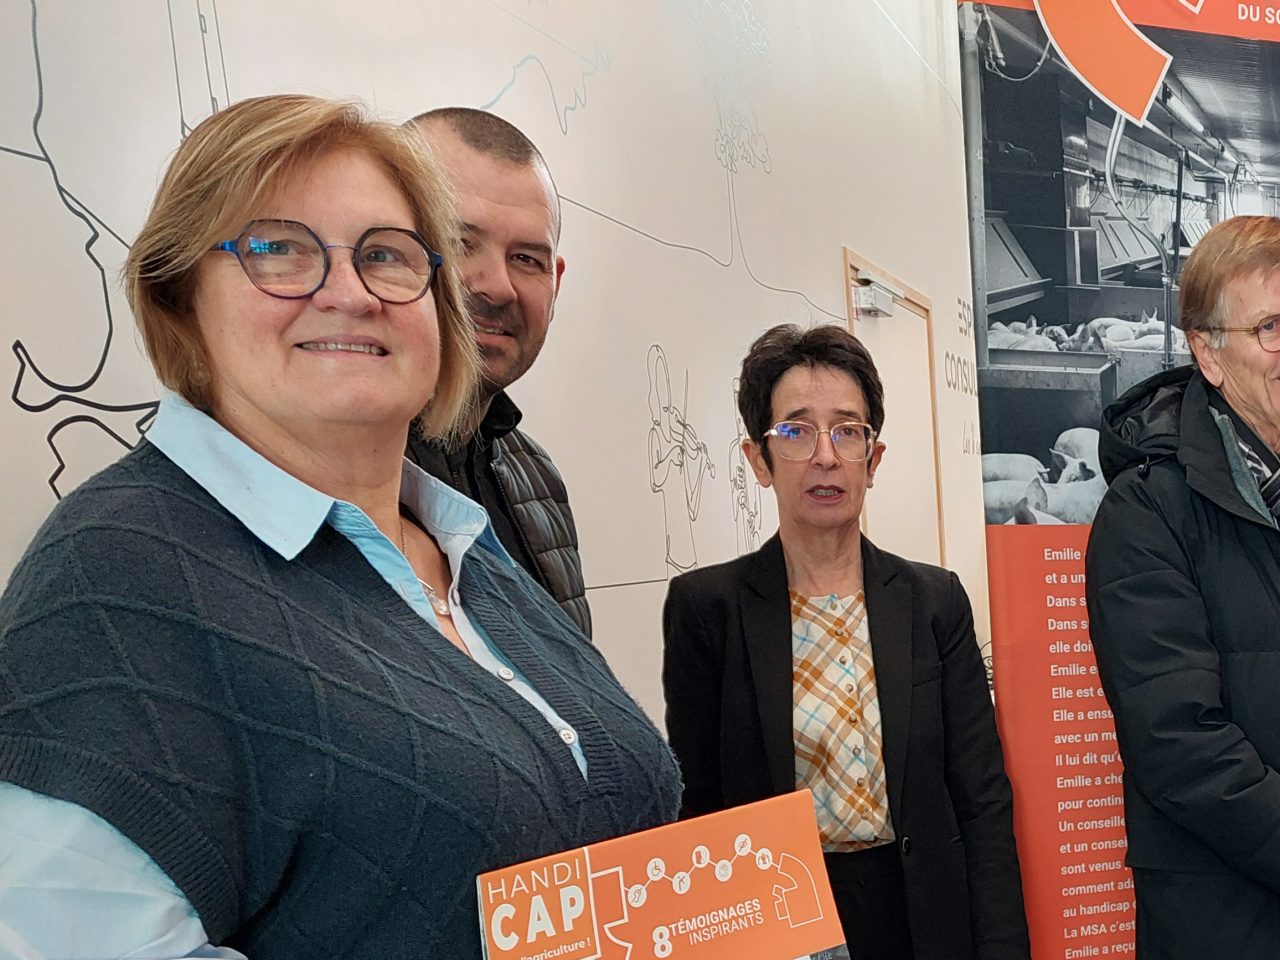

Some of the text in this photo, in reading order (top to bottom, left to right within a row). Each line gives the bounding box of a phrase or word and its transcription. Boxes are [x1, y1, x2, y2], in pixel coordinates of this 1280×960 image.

[1237, 4, 1260, 22] DU
[1044, 548, 1081, 560] Emilie
[1045, 573, 1057, 584] et
[1060, 575, 1067, 584] a
[1047, 595, 1076, 607] Dans
[1048, 619, 1078, 630] Dans
[1049, 641, 1070, 653] elle
[1050, 664, 1086, 676] Emilie
[1052, 687, 1073, 699] Elle
[1076, 687, 1094, 697] est
[1053, 710, 1074, 721] Elle
[1078, 712, 1084, 720] a
[1054, 734, 1081, 744] avec
[1085, 733, 1098, 742] un
[1066, 754, 1080, 765] lui
[1083, 752, 1098, 764] dit
[1057, 775, 1091, 788] Emilie
[1094, 778, 1102, 786] a
[1058, 800, 1084, 813] pour
[1059, 821, 1074, 832] Un
[1060, 843, 1071, 853] et
[1074, 843, 1088, 852] un
[1061, 863, 1085, 875] sont
[1088, 860, 1122, 871] venus
[487, 858, 581, 903] HANDI
[1062, 881, 1114, 896] comment
[1063, 907, 1077, 918] au
[1080, 900, 1130, 916] handicap
[491, 885, 585, 951] CAP
[652, 898, 761, 958] 8 TÉMOIGNAGES
[689, 912, 764, 945] INSPIRANTS
[1064, 928, 1078, 938] La
[1081, 924, 1107, 937] MSA
[1065, 942, 1135, 960] Emilie a reçu
